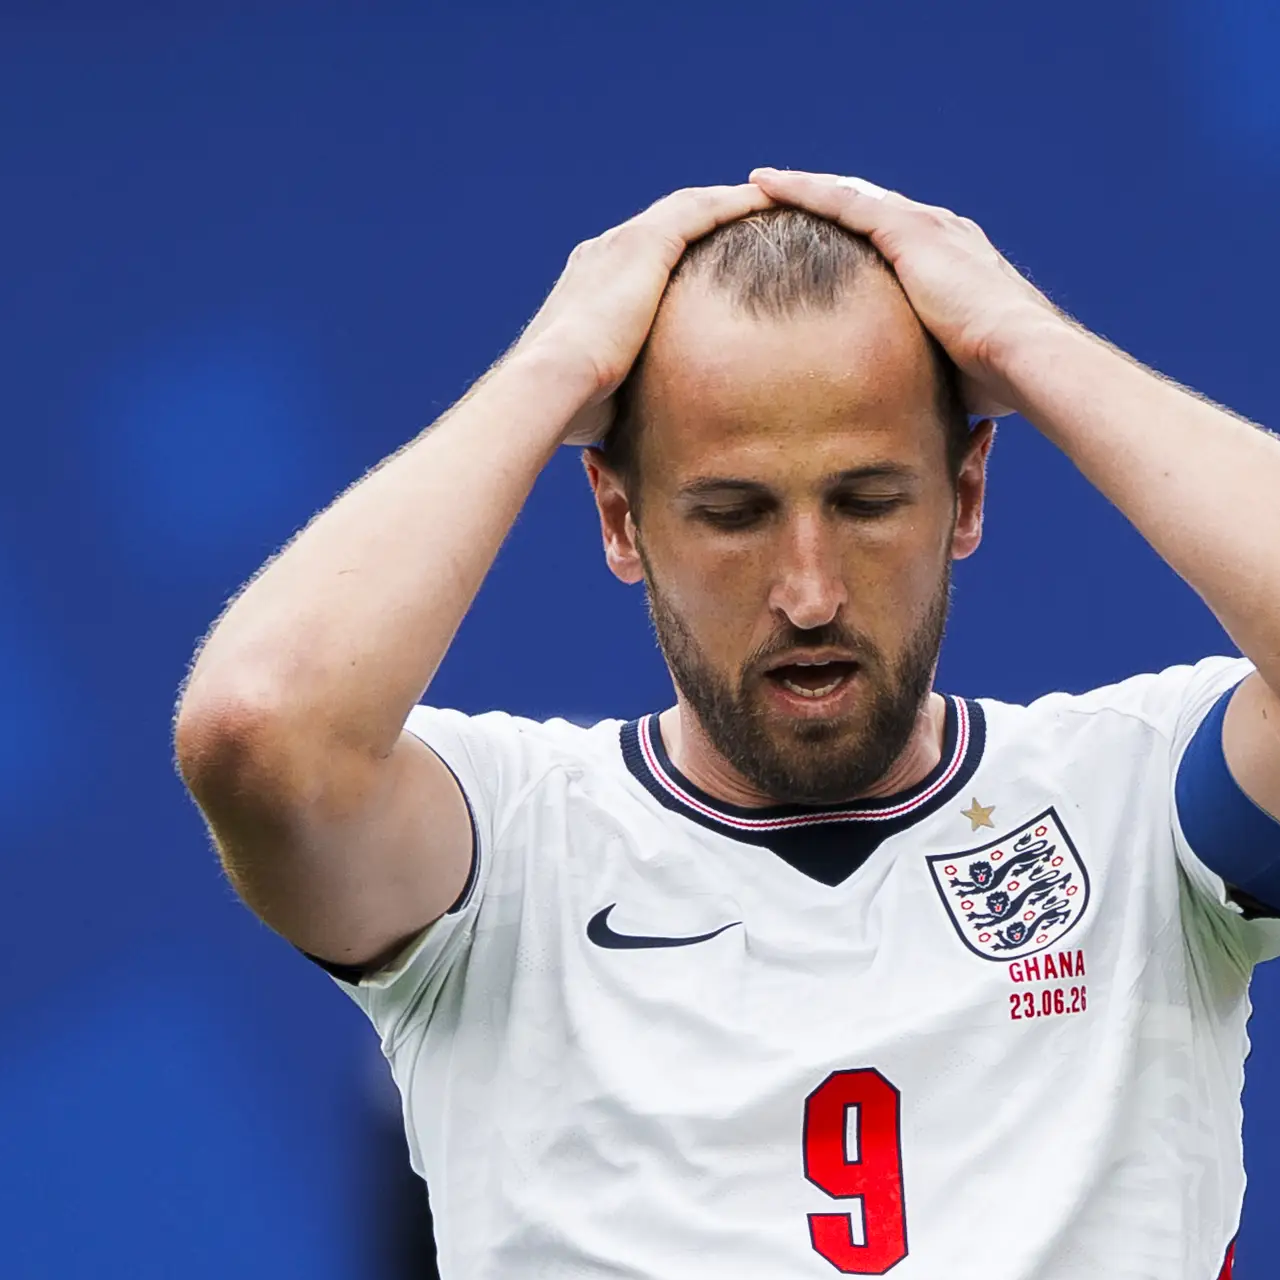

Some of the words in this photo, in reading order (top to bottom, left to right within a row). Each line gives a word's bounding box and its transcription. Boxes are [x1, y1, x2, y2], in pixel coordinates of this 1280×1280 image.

[1009, 949, 1086, 983] GHANA
[1009, 986, 1087, 1020] 23.06.26
[802, 1066, 909, 1276] 9
